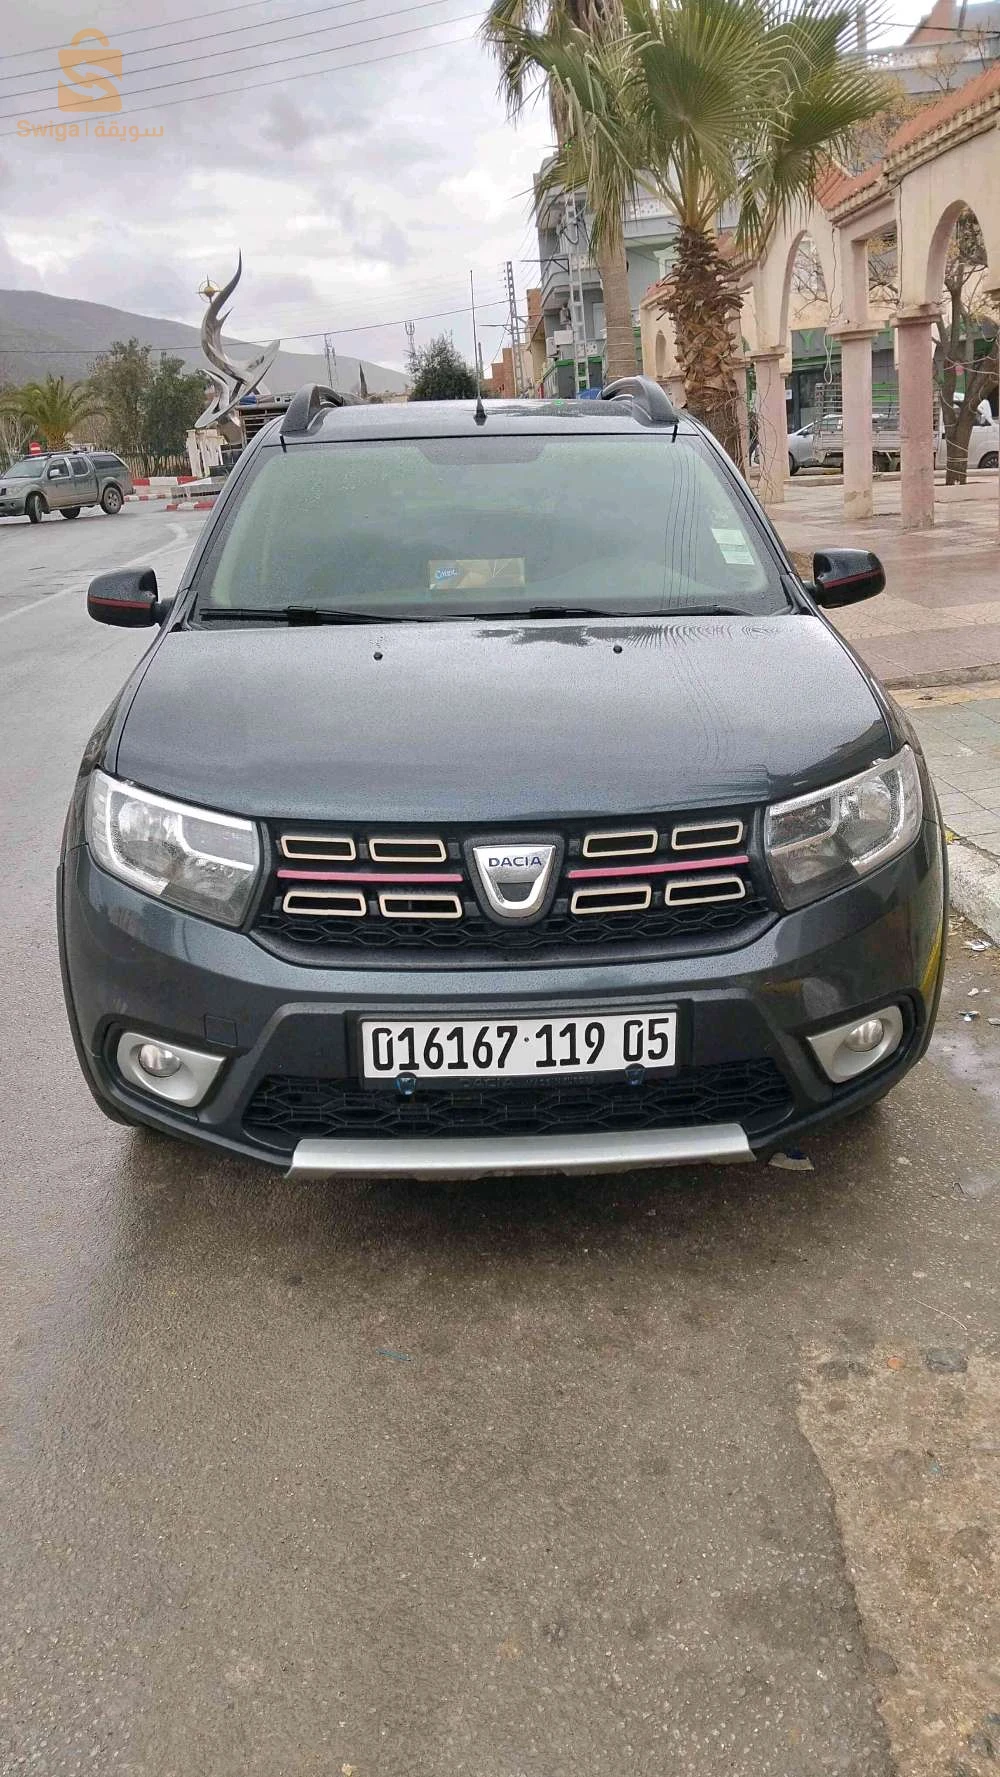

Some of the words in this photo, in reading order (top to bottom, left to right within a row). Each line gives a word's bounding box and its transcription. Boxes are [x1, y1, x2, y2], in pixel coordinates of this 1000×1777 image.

[488, 856, 542, 867] DACIA
[371, 1025, 518, 1071] 016167
[535, 1021, 605, 1067] 119
[622, 1017, 669, 1062] 05
